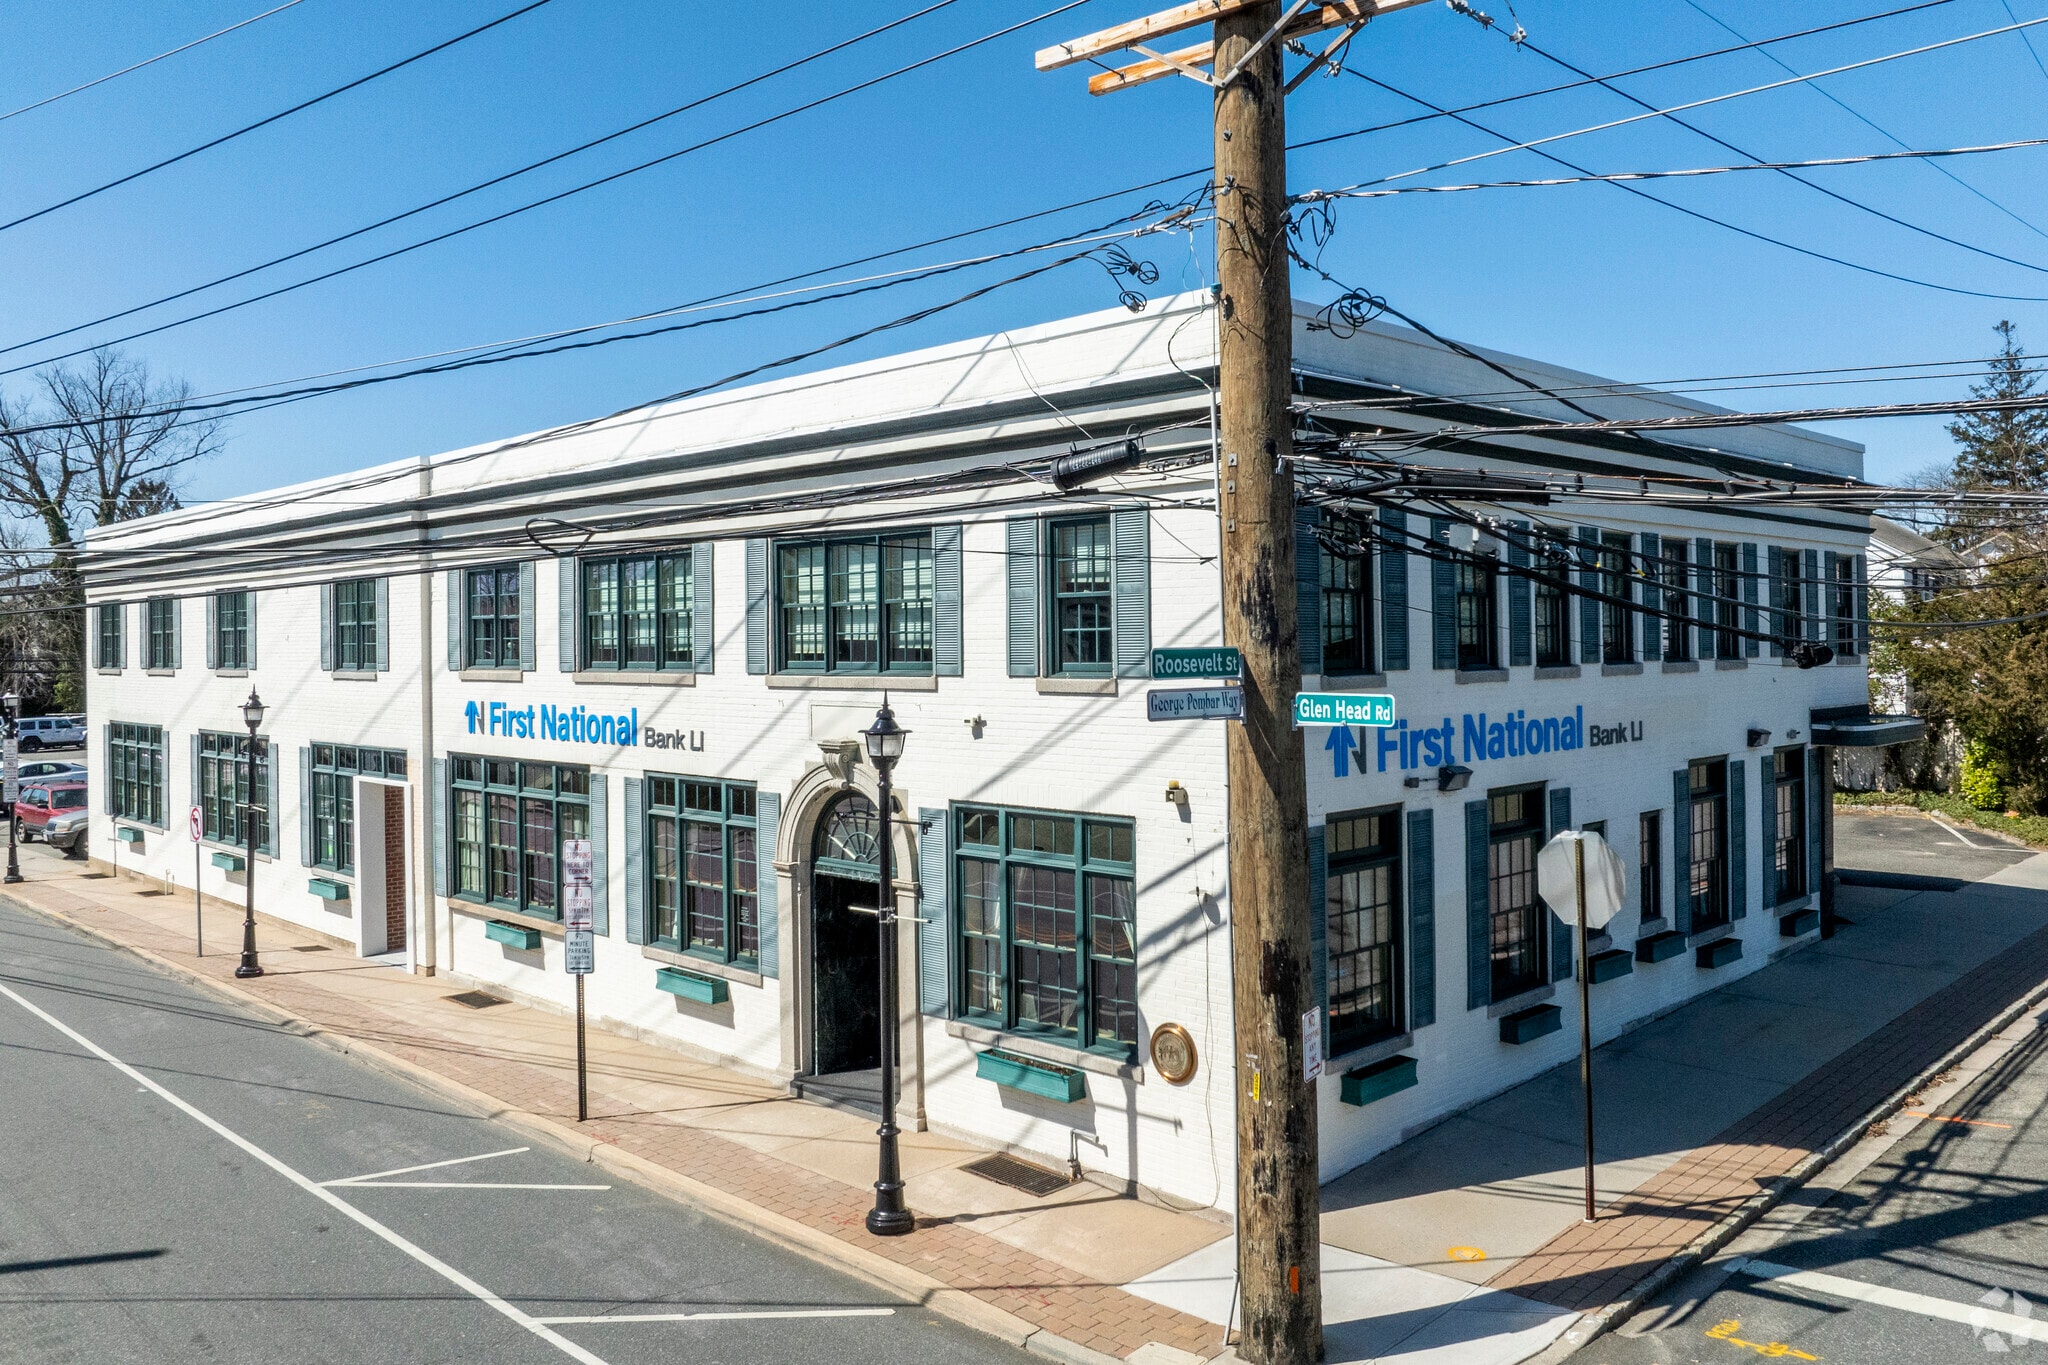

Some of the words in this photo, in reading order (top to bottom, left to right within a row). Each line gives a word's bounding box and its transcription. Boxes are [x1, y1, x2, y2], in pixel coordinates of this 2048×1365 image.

[1154, 653, 1223, 675] Roosevelt
[1225, 656, 1238, 672] St
[1150, 692, 1185, 715] George
[1221, 690, 1239, 712] Way
[1299, 698, 1331, 719] Glen
[1334, 698, 1371, 721] Head
[1375, 704, 1391, 721] Rd
[489, 702, 535, 739] First
[541, 703, 637, 747] National
[644, 726, 685, 751] Bank
[690, 730, 705, 752] LI
[1377, 716, 1455, 773] First
[1463, 705, 1584, 763] National
[1590, 722, 1628, 748] Bank
[1630, 720, 1643, 742] LI
[566, 851, 591, 860] STOPPING
[574, 843, 583, 852] NO
[574, 888, 583, 898] NO
[567, 898, 591, 907] STOPPING
[569, 940, 589, 948] MINUTE
